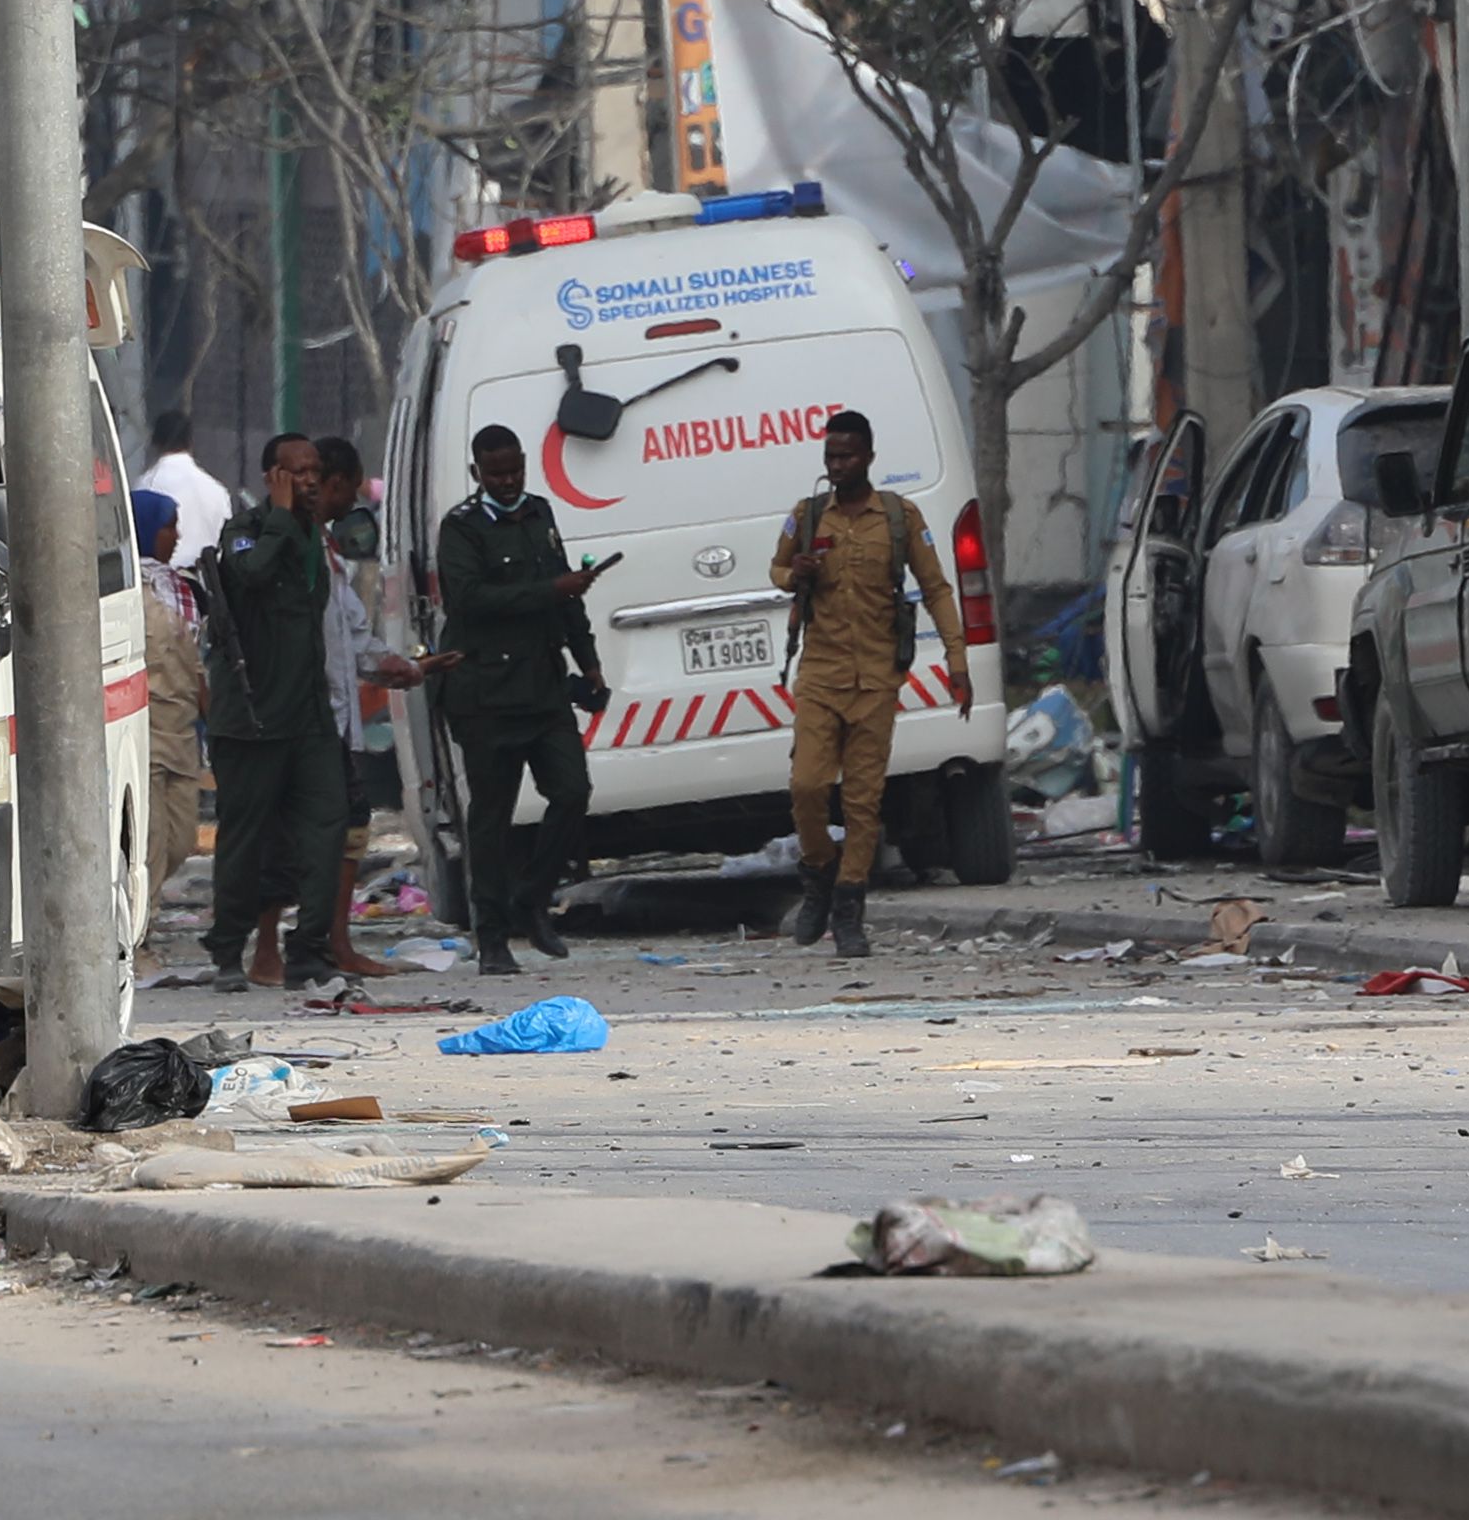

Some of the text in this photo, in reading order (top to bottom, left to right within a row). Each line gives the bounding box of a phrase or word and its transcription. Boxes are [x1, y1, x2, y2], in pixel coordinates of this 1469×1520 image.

[596, 259, 815, 304] SOMALI SUDANESE
[598, 281, 817, 323] SPECIALIZED HOSPITAL
